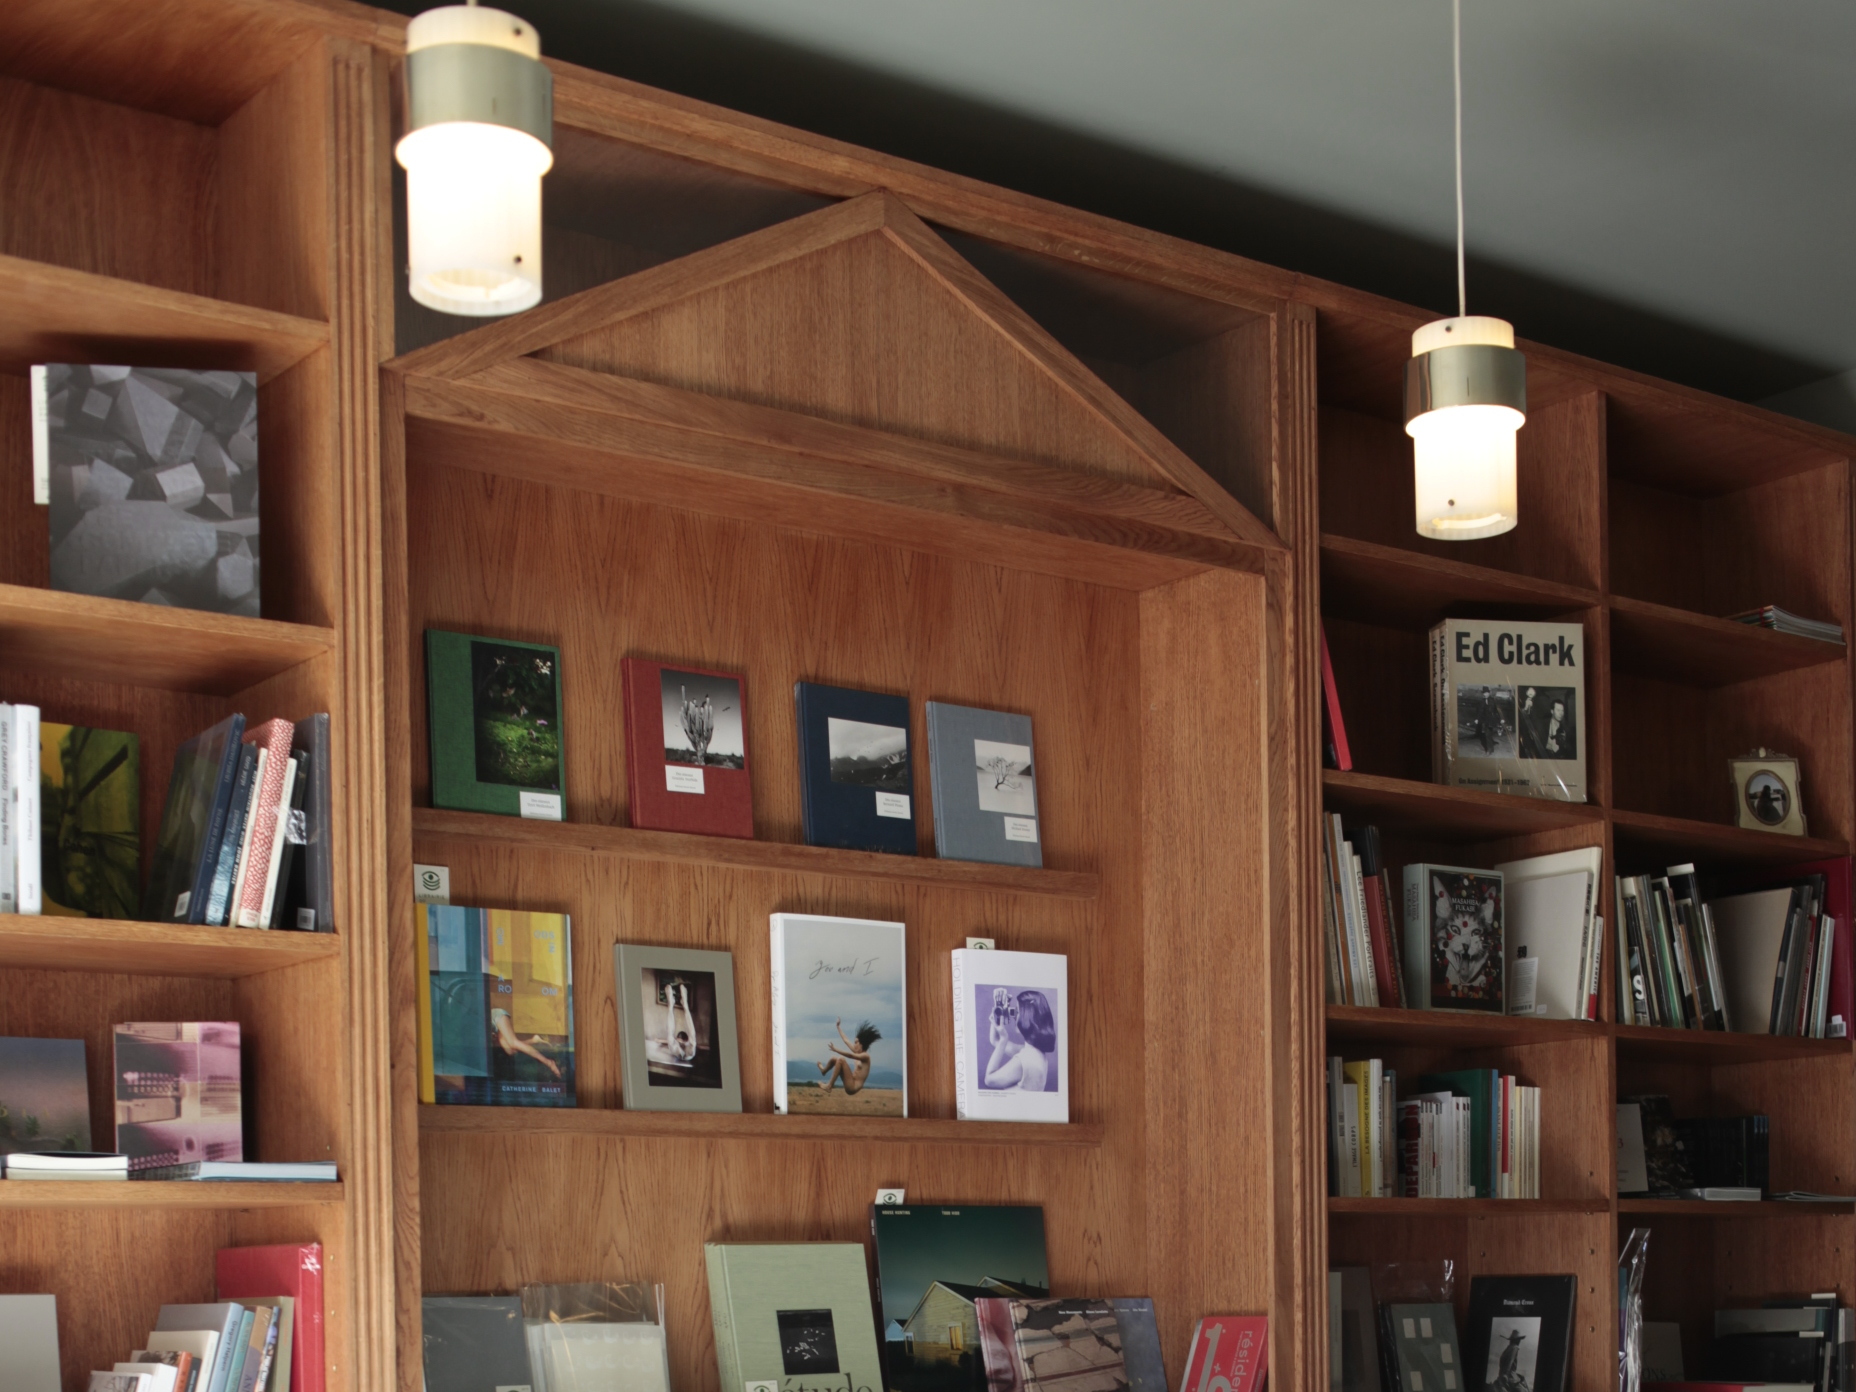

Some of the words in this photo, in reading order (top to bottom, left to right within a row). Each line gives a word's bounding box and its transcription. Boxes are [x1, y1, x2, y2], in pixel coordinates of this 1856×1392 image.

[1456, 631, 1490, 664] Ed
[1497, 632, 1576, 667] Clark
[1, 798, 9, 822] Finding
[1452, 898, 1480, 906] MASAHISA
[1455, 904, 1476, 912] FUKASE
[1359, 893, 1369, 939] Friedlander
[1367, 942, 1375, 979] Portraits
[837, 957, 859, 975] and
[498, 984, 512, 993] RO
[541, 987, 558, 996] OM
[952, 957, 962, 1021] HOLDING
[956, 1027, 964, 1055] THE
[956, 1061, 966, 1119] CAMERA
[227, 1321, 238, 1346] Gregory
[221, 1347, 231, 1372] Halpern
